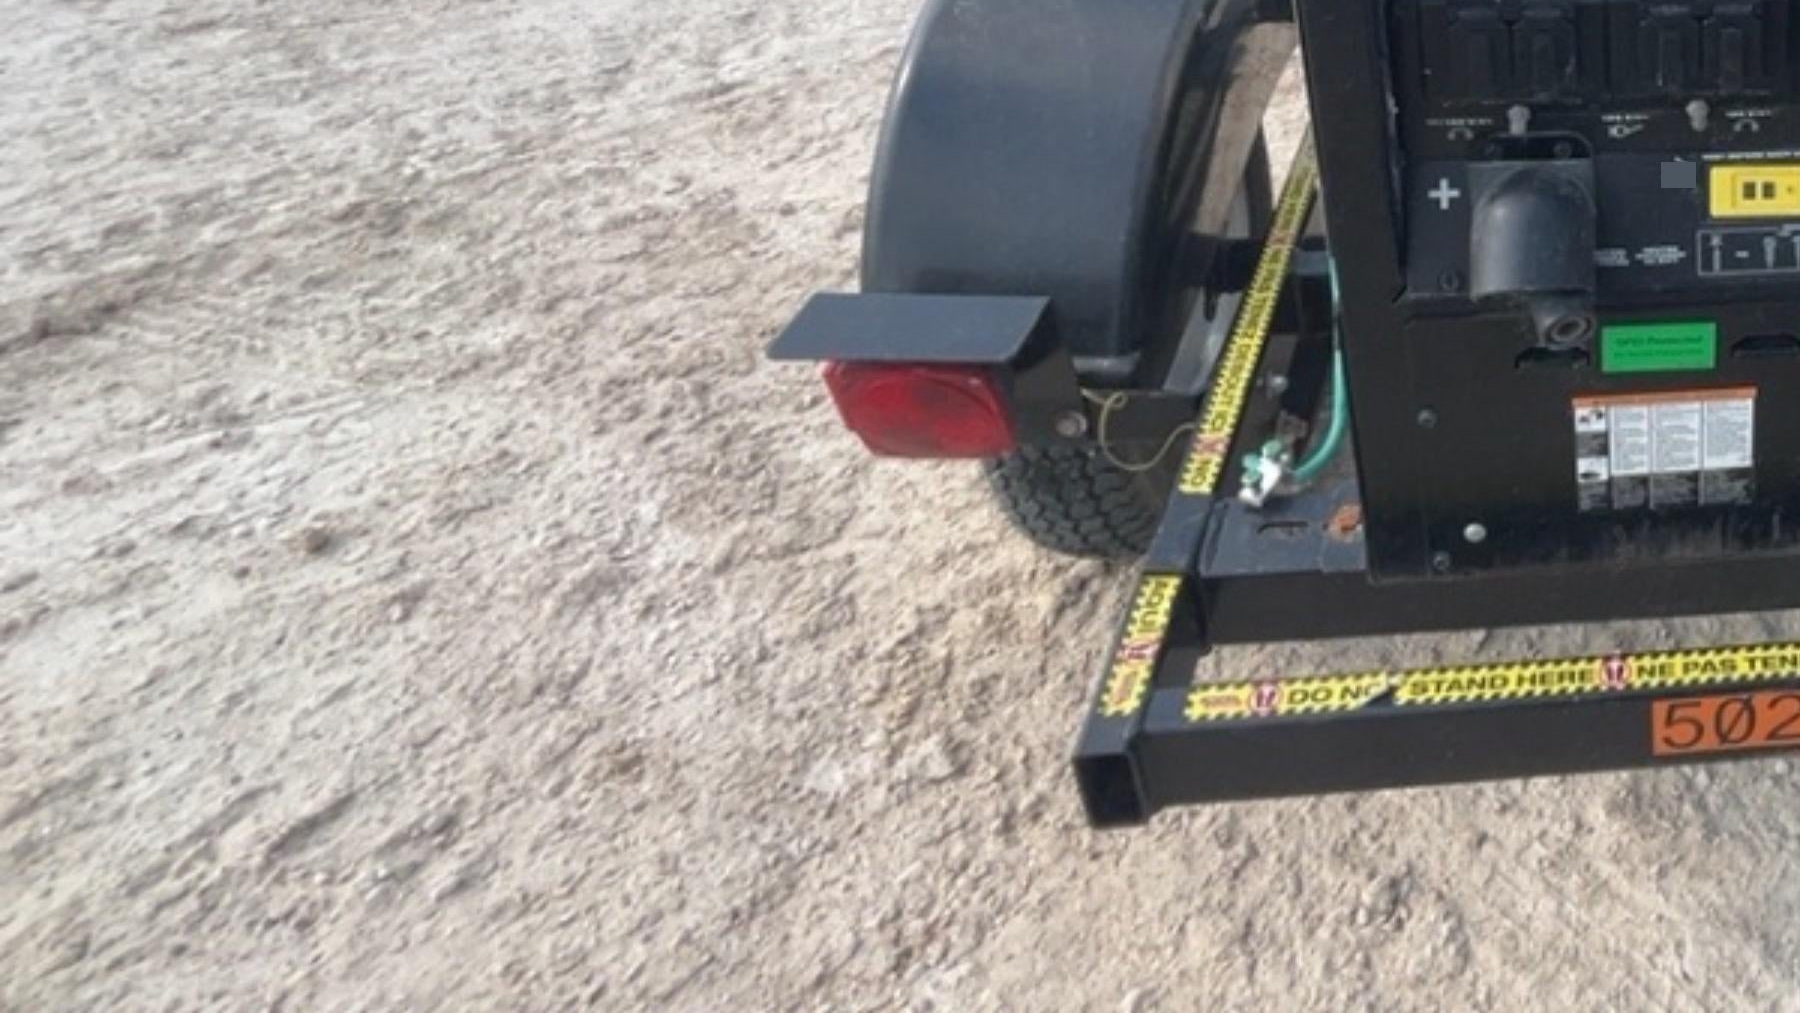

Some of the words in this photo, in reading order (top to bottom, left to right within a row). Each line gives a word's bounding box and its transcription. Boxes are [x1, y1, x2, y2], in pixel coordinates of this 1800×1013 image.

[1636, 664, 1676, 679] NE
[1682, 658, 1738, 675] PAS
[1287, 688, 1334, 705] DO
